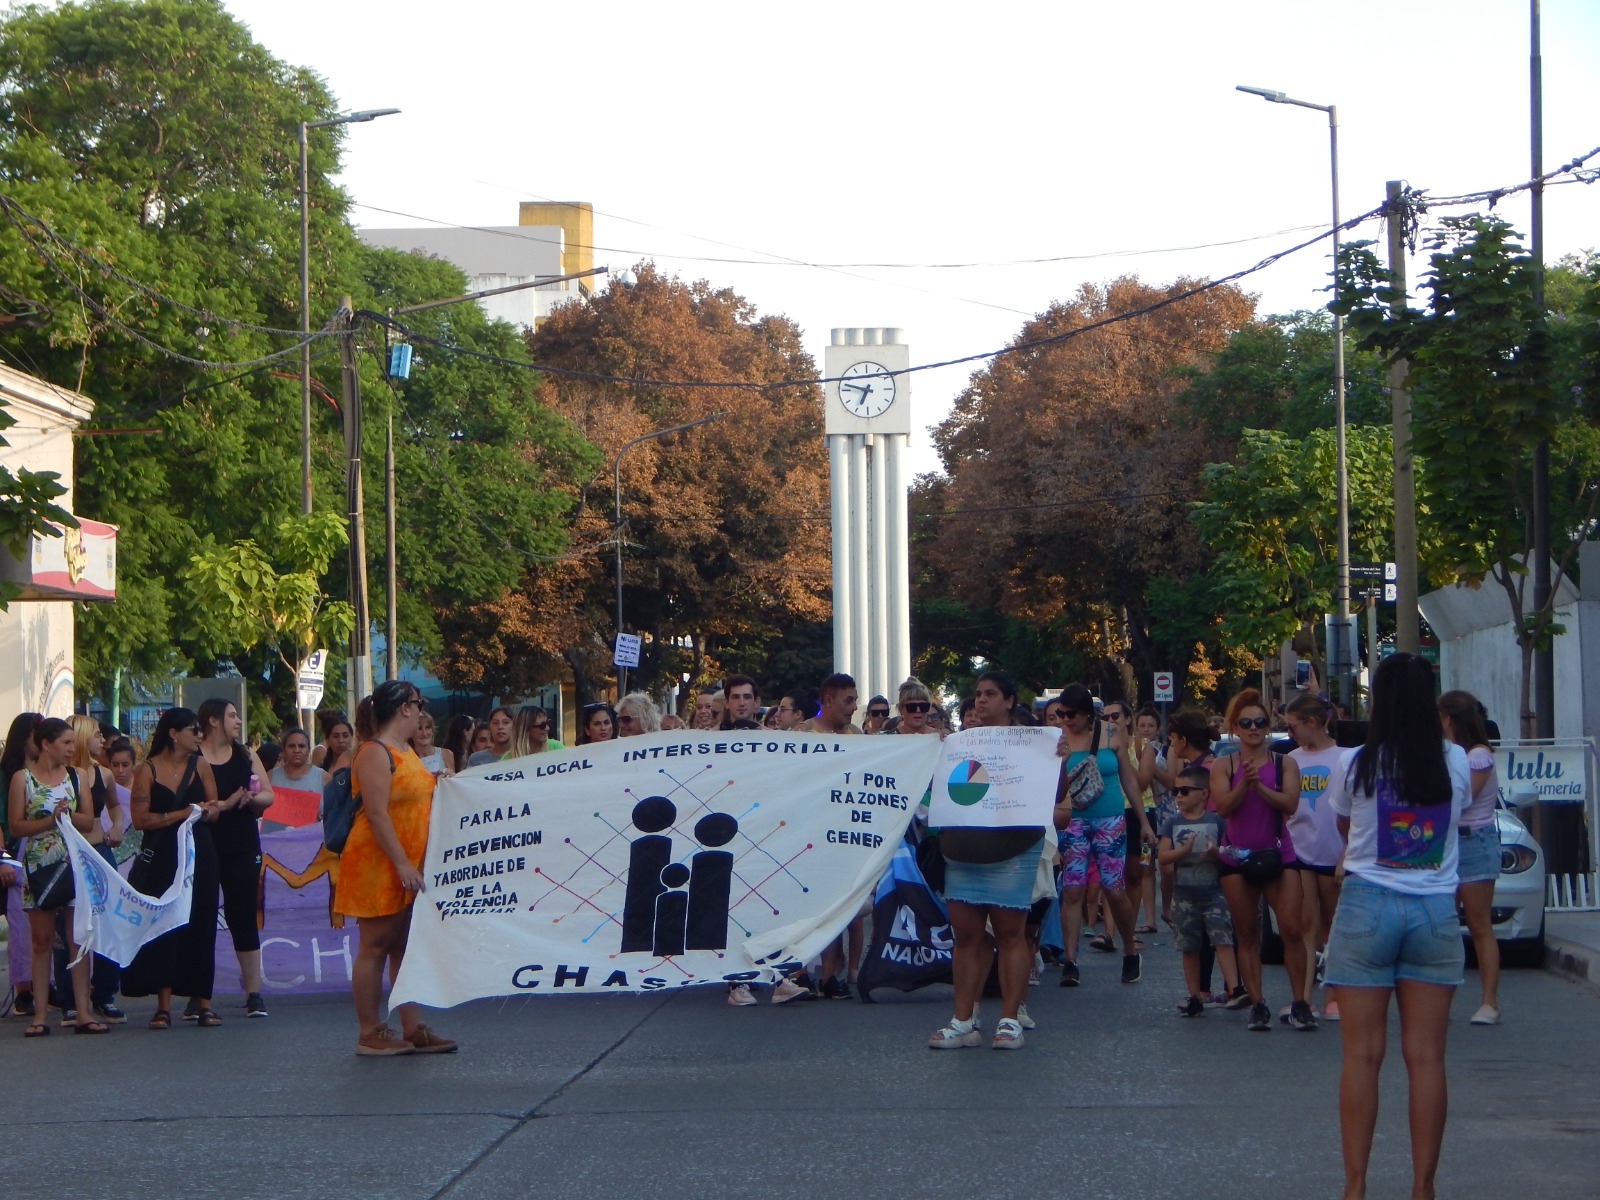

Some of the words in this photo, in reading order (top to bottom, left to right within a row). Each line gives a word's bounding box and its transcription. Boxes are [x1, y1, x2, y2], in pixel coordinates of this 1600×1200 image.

[536, 759, 593, 777] LOCAL
[623, 742, 846, 762] INTERSECTORIAL
[1507, 751, 1564, 780] lulu
[843, 771, 852, 784] Y
[863, 773, 896, 790] POR
[1300, 774, 1332, 792] REW
[830, 790, 909, 811] RAZONES
[460, 807, 504, 829] PARA
[507, 803, 531, 818] LA
[851, 809, 872, 823] DE
[443, 830, 542, 863] PREVENCION
[826, 829, 887, 848] GENER
[507, 857, 526, 873] DE
[455, 886, 474, 899] DE
[481, 881, 502, 895] LA
[435, 892, 519, 911] VIOLENCIA
